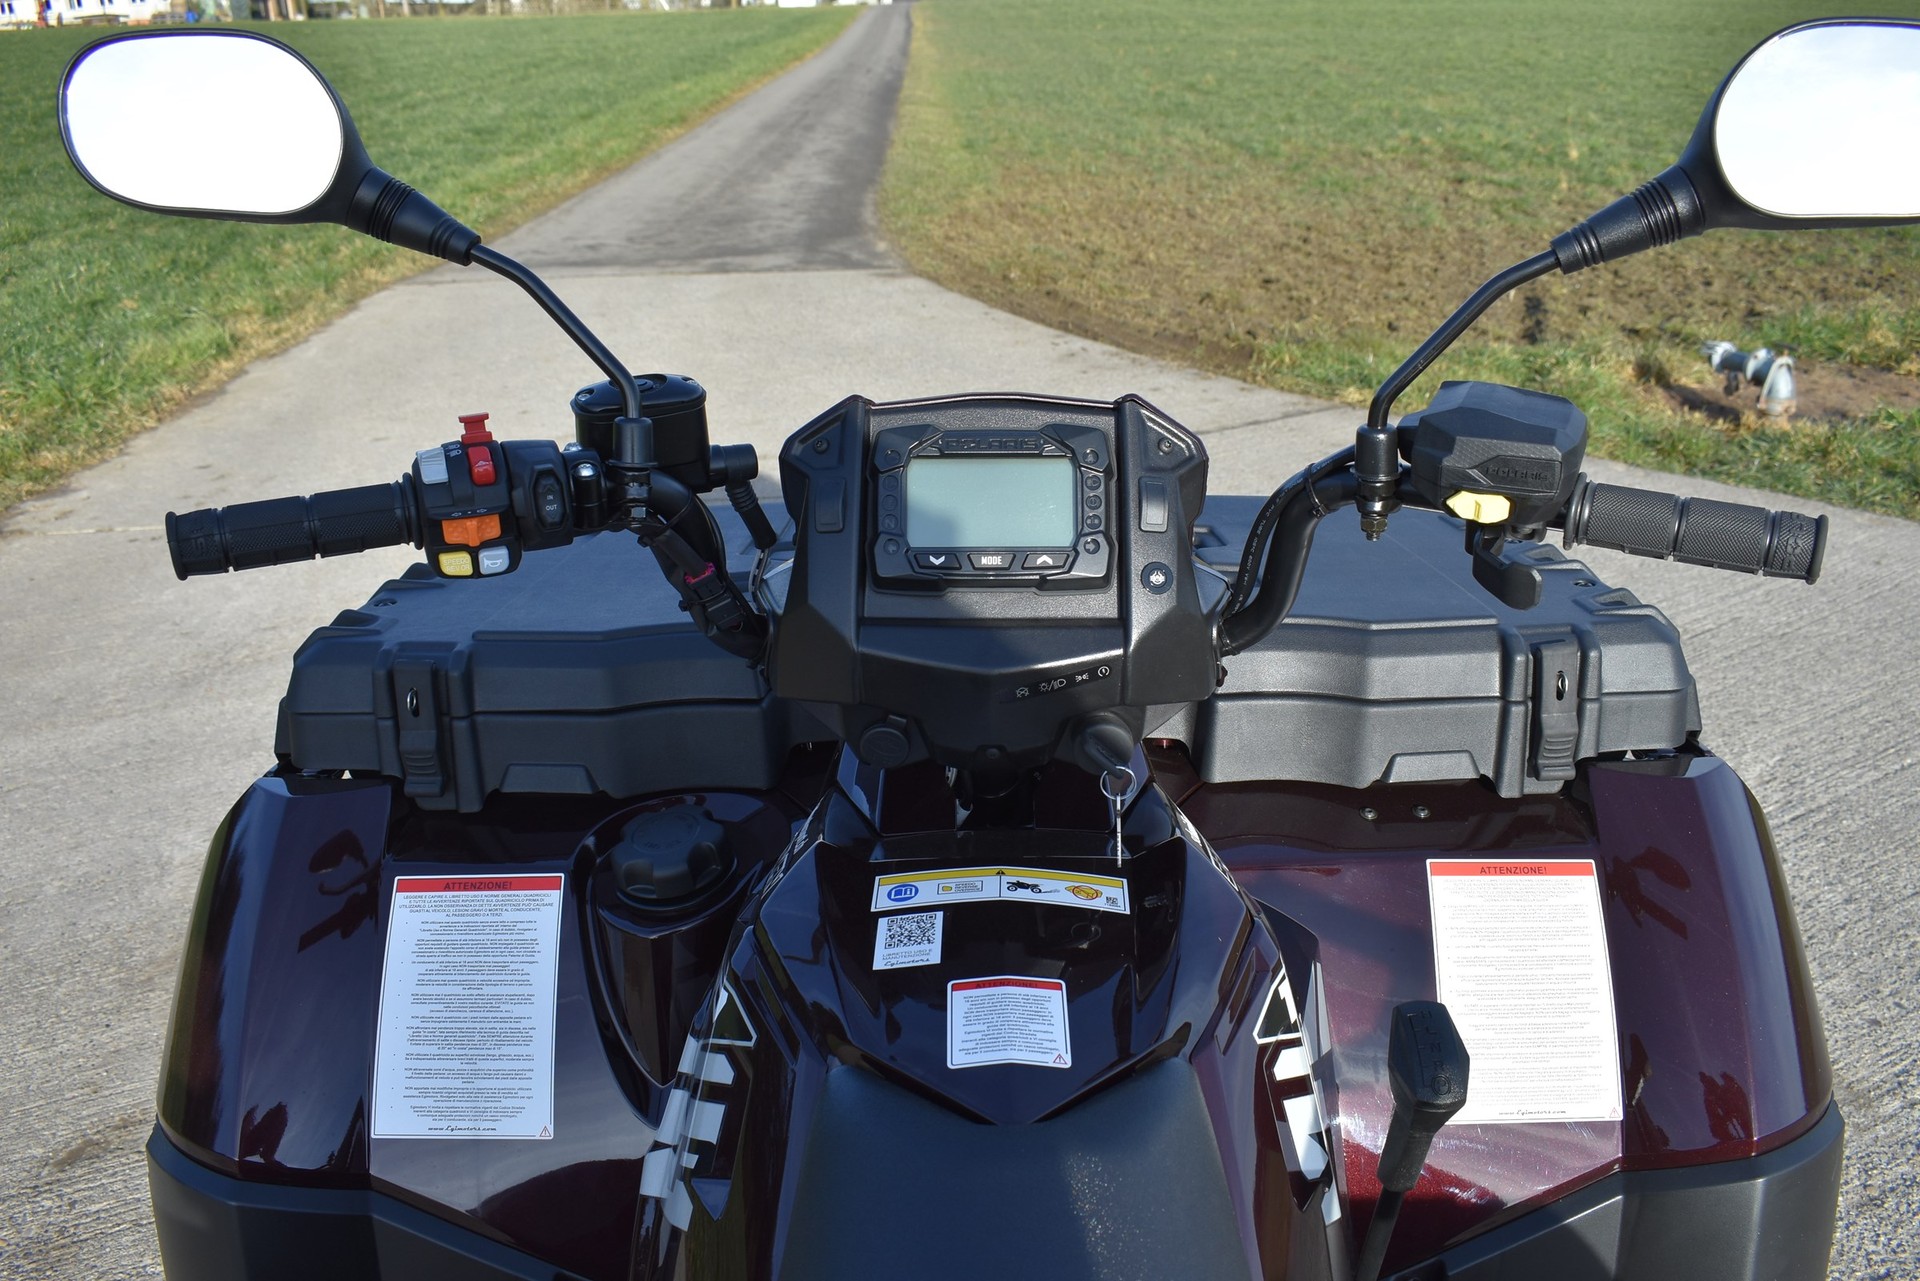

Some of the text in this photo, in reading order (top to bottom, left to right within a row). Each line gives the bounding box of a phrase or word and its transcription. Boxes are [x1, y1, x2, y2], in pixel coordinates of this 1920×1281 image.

[944, 437, 1037, 450] POLARIS
[981, 556, 1003, 565] MODE
[1479, 866, 1548, 875] ATTENZIONE!
[443, 881, 512, 890] ATTENZIONE!
[976, 980, 1038, 988] ATTENZIONE!
